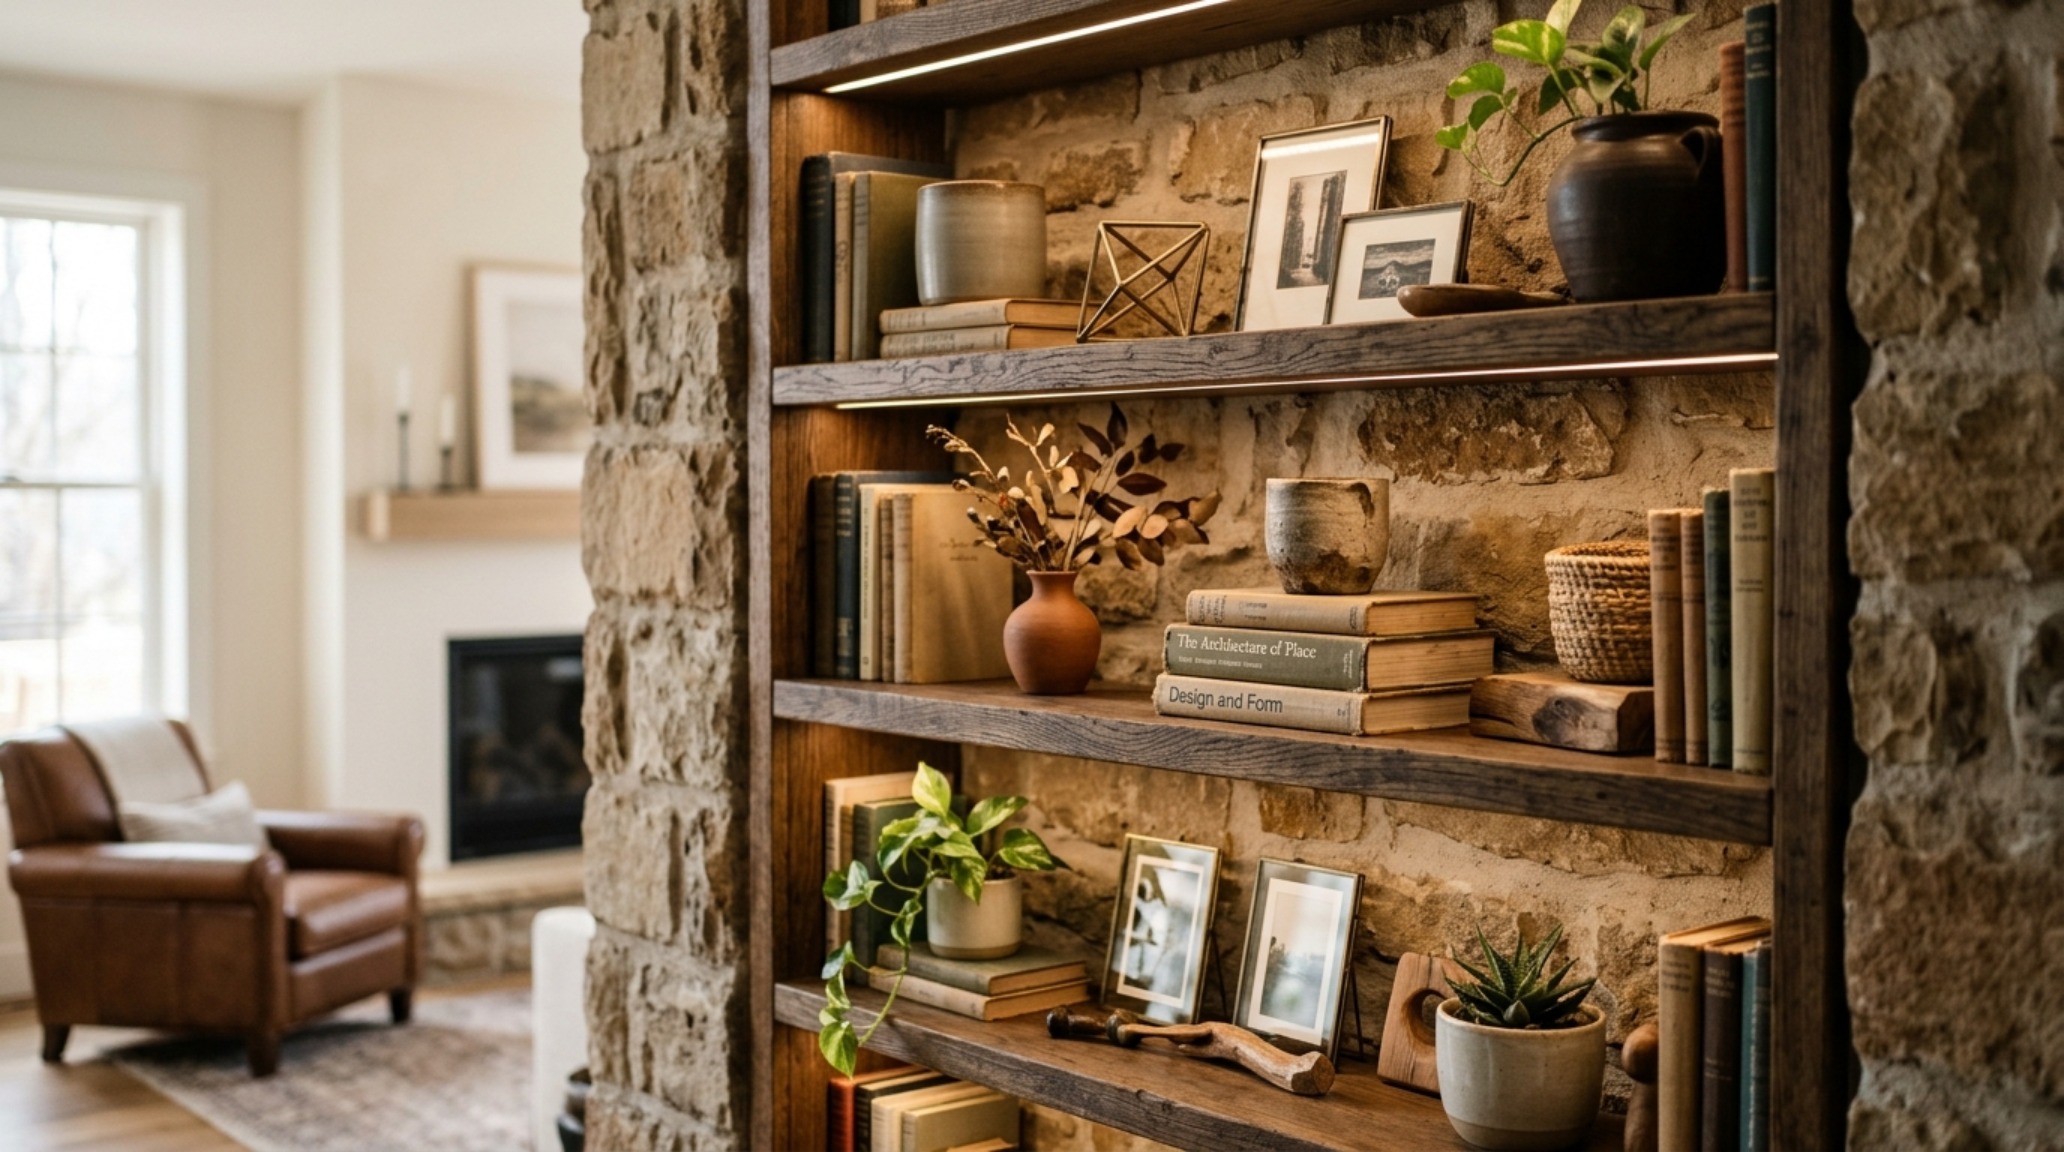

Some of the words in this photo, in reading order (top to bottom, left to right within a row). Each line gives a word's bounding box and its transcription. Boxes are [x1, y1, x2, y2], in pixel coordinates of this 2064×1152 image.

[1177, 634, 1197, 649] The
[1270, 640, 1283, 655] of
[1284, 641, 1317, 659] Place
[1169, 686, 1214, 710] Design
[1217, 693, 1243, 709] and
[1247, 693, 1283, 713] Form
